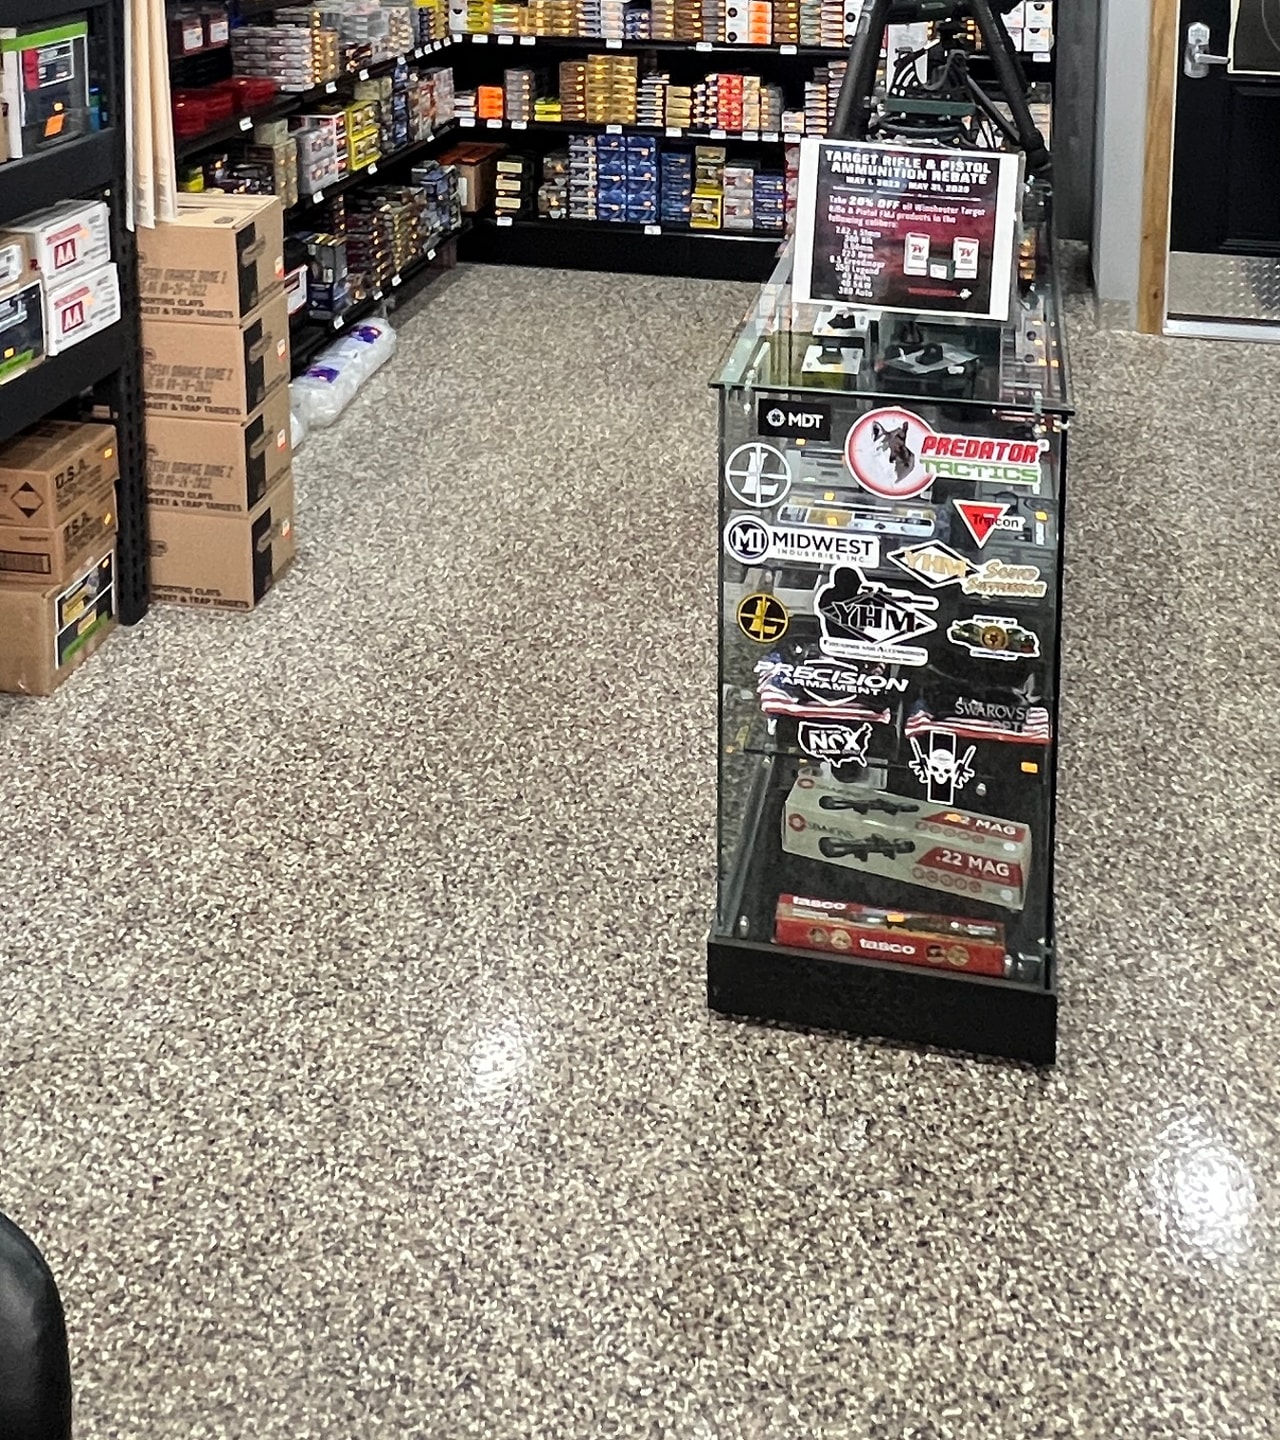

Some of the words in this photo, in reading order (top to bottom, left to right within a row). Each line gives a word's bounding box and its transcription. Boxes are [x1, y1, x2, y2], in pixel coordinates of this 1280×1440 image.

[826, 150, 877, 165] TARGET
[883, 155, 921, 168] RIFLE
[926, 160, 936, 170] &
[941, 160, 991, 174] PISTOL
[831, 162, 927, 180] AMMUNITION
[932, 170, 987, 185] REBATE
[877, 199, 900, 209] OFF
[56, 240, 76, 268] AA
[788, 414, 823, 429] MDT
[921, 434, 1040, 464] PREDATOR
[920, 458, 1038, 483] TACTICS
[187, 491, 213, 500] CLAYS
[772, 532, 874, 557] MIDWEST
[905, 550, 966, 577] YHM
[835, 603, 916, 632] YHM
[753, 662, 909, 693] PRECISION
[781, 676, 881, 696] ARMAMENT
[975, 818, 1017, 835] MAG
[936, 849, 962, 866] .22
[968, 856, 1010, 878] MAG
[793, 896, 846, 910] tasco
[860, 938, 916, 955] tasco
